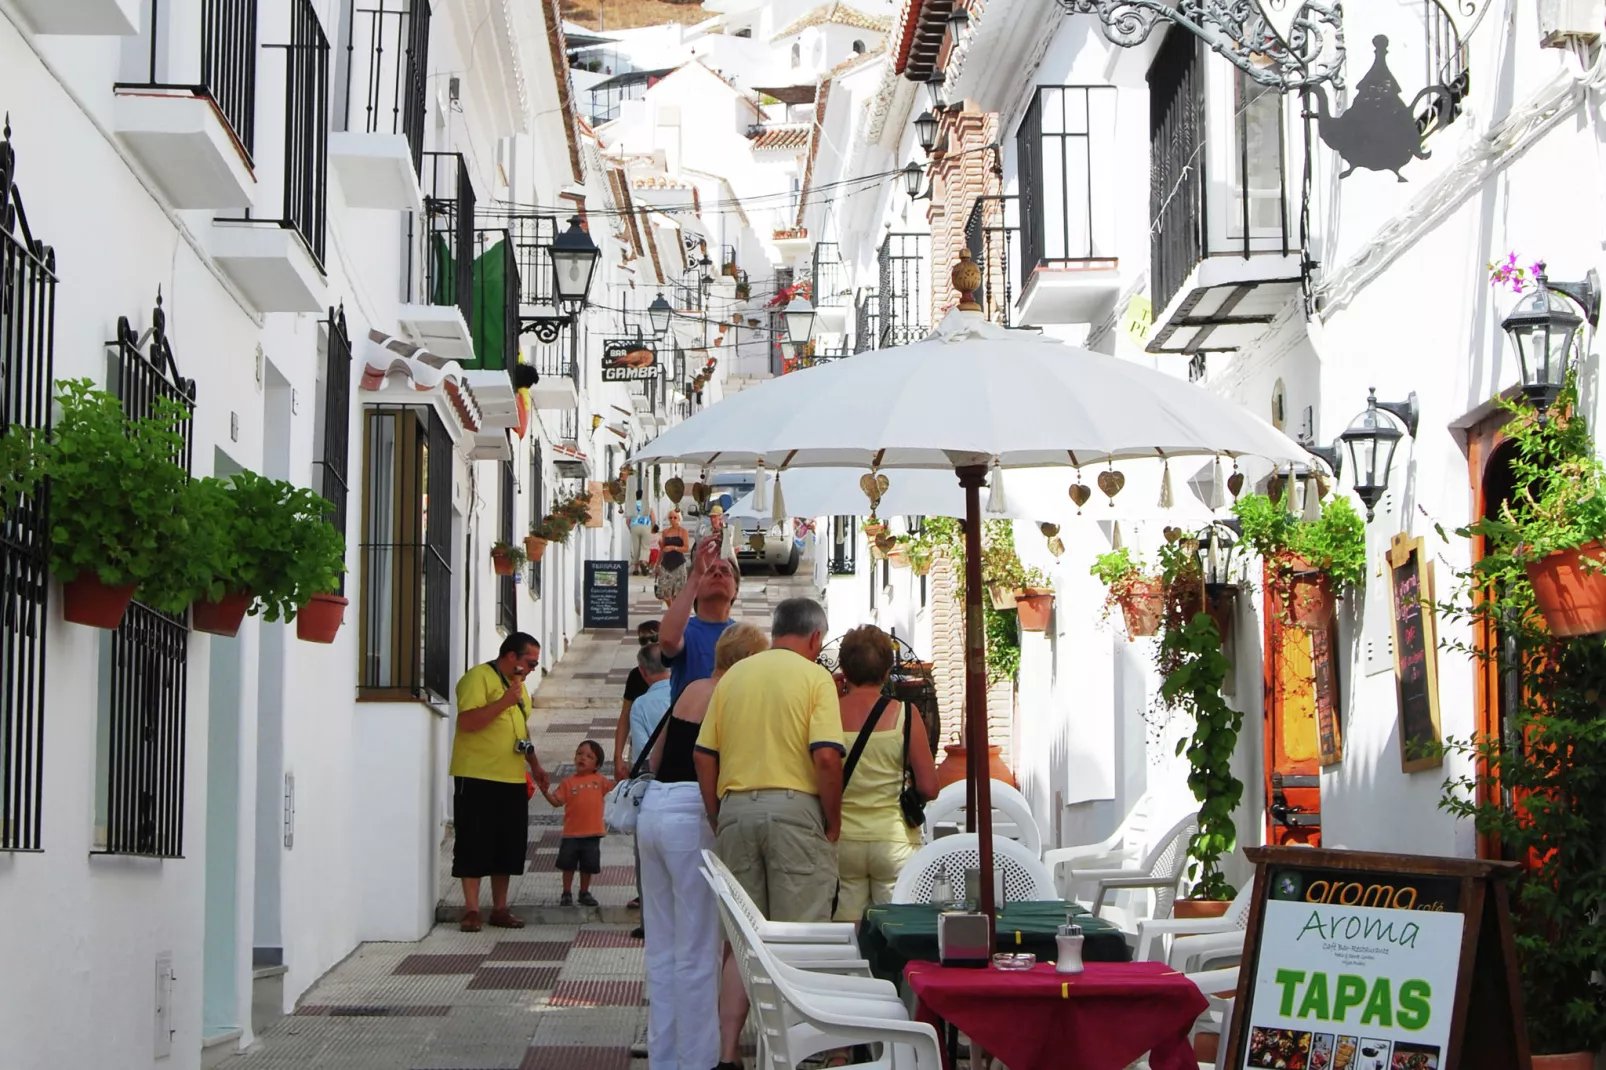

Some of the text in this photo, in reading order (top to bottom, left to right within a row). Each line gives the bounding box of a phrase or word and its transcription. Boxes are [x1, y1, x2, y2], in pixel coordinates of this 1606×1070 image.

[610, 349, 627, 357] BAR
[605, 366, 658, 380] GAMBA
[1306, 880, 1417, 910] aroma
[1296, 910, 1420, 949] Aroma
[1275, 968, 1432, 1032] TAPAS
